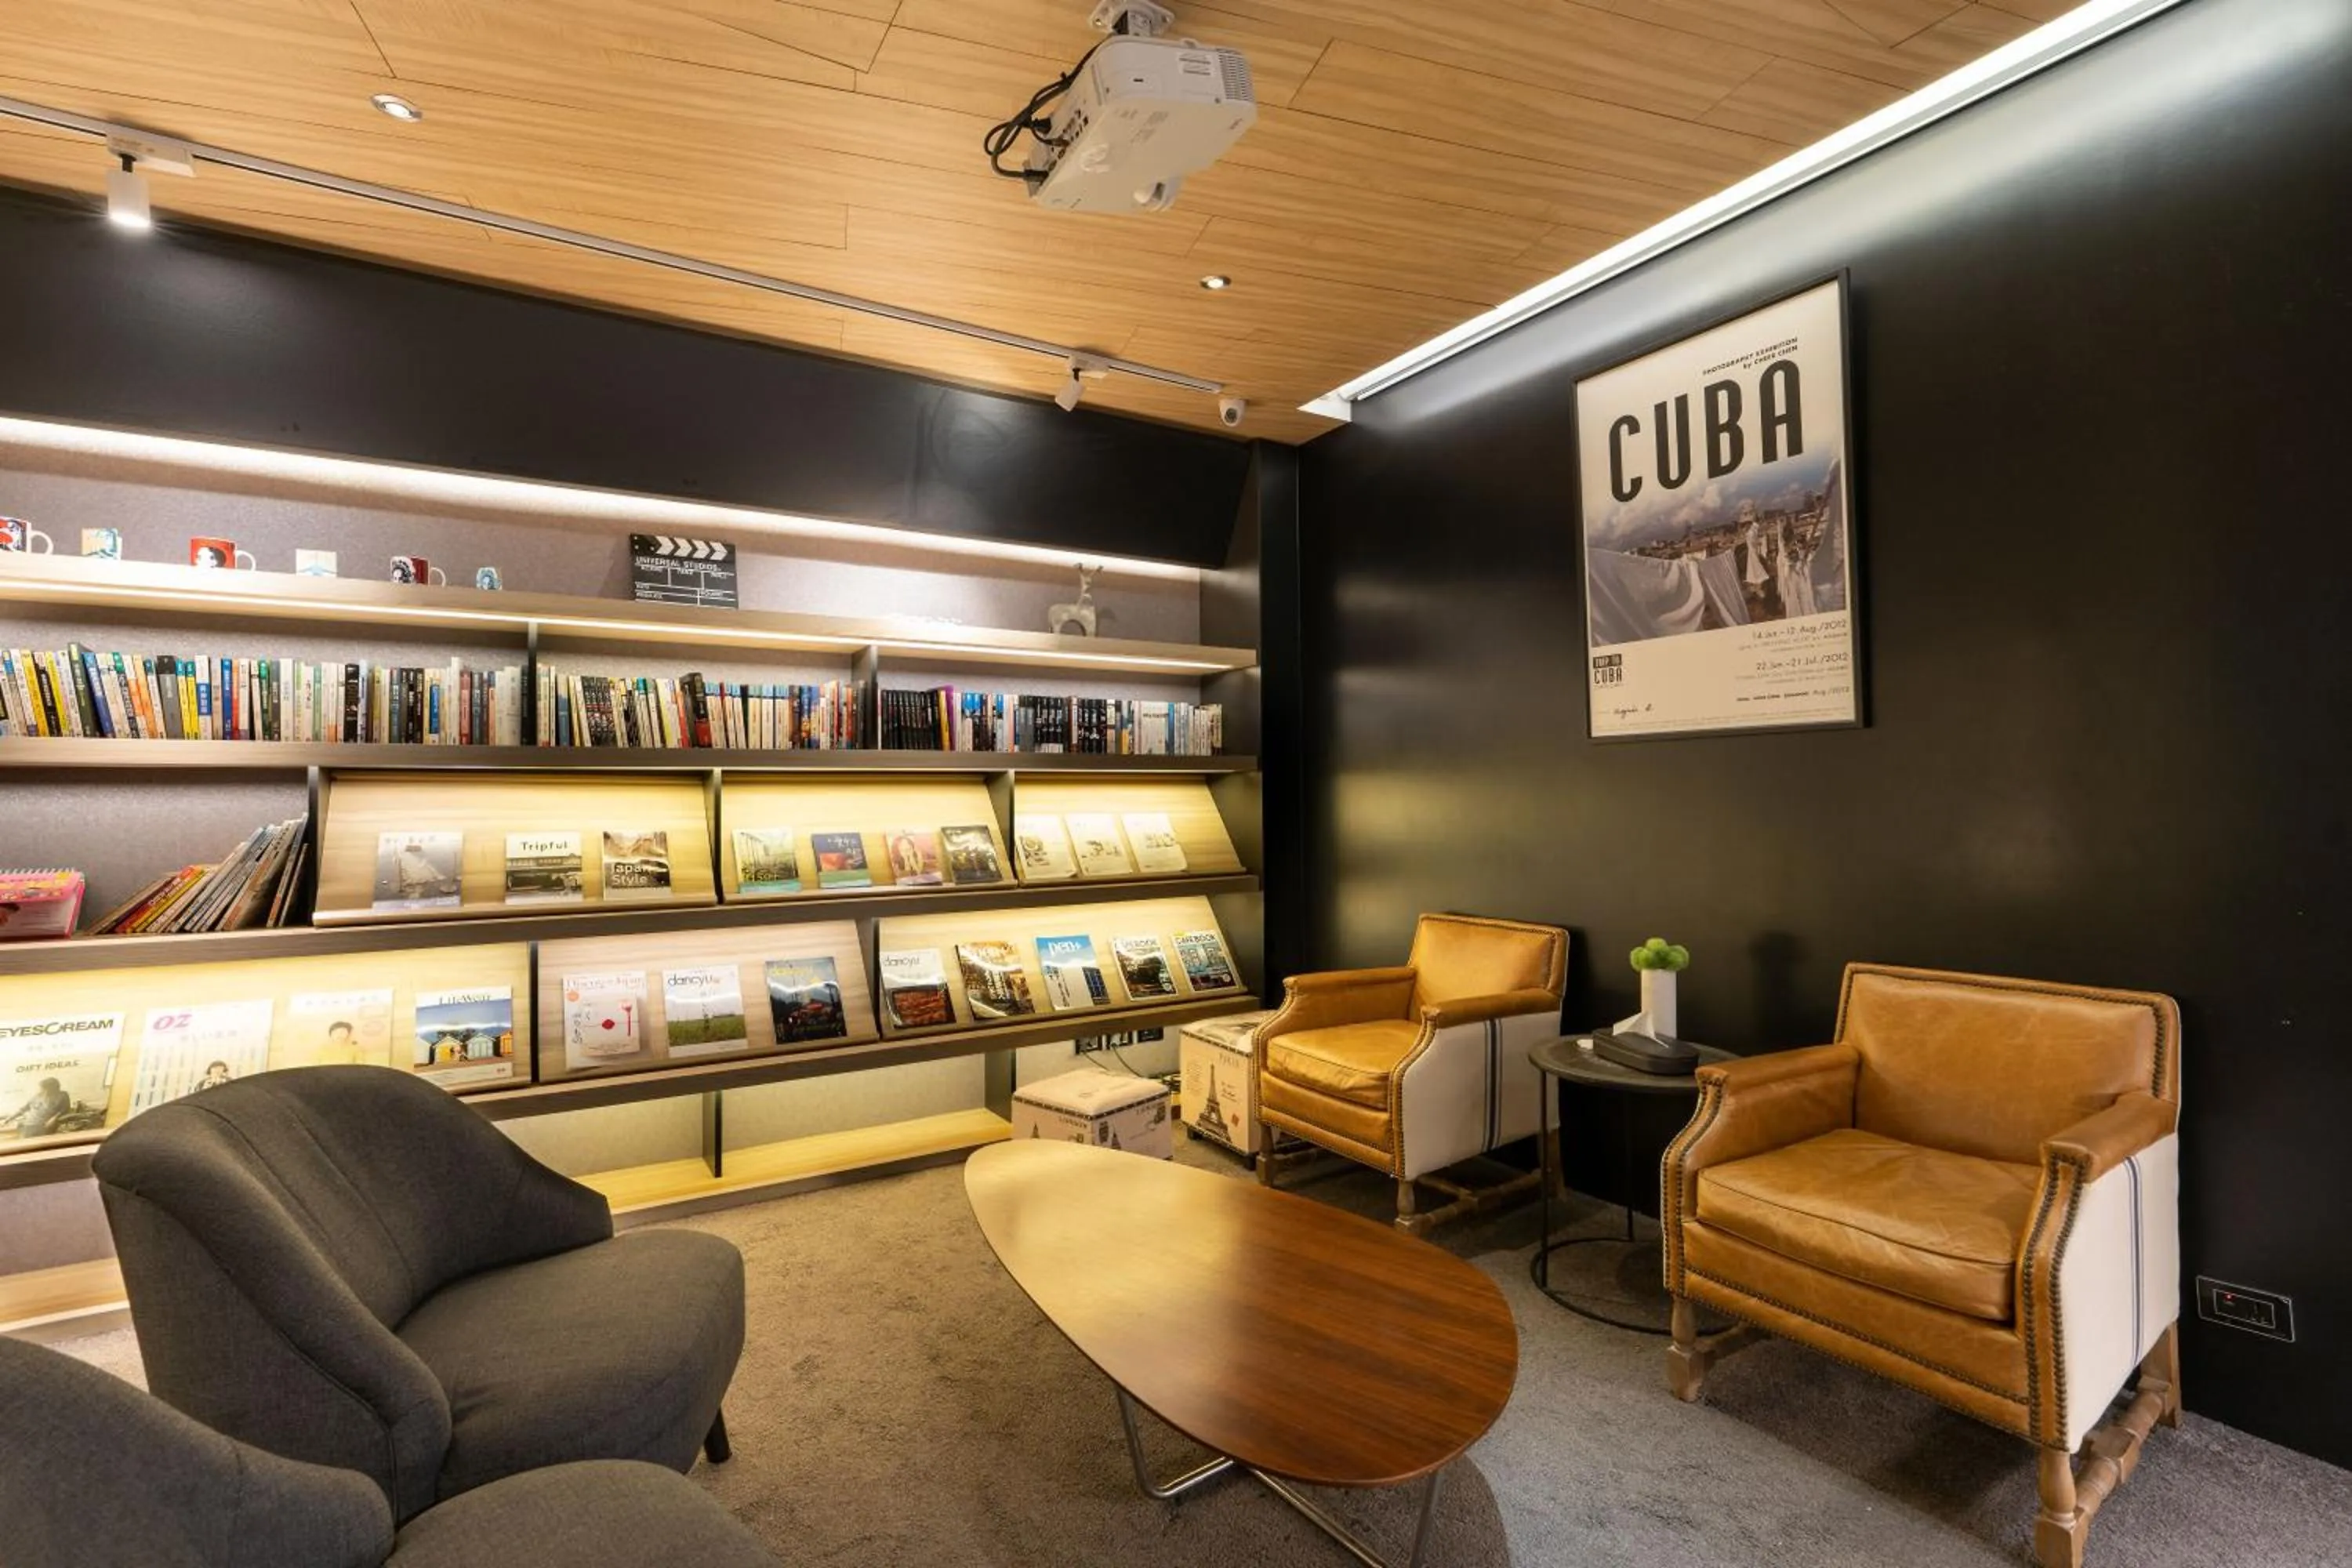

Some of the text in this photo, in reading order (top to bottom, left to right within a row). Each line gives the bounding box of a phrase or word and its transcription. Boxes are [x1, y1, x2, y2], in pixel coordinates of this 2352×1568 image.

[1609, 359, 1804, 503] CUBA
[636, 556, 680, 568] UNIVERSAL
[1594, 667, 1622, 684] CUBA
[521, 840, 568, 852] Tripful
[612, 874, 648, 887] Style
[153, 1014, 193, 1031] OZ
[16, 1060, 82, 1073] GIFT IDEAS
